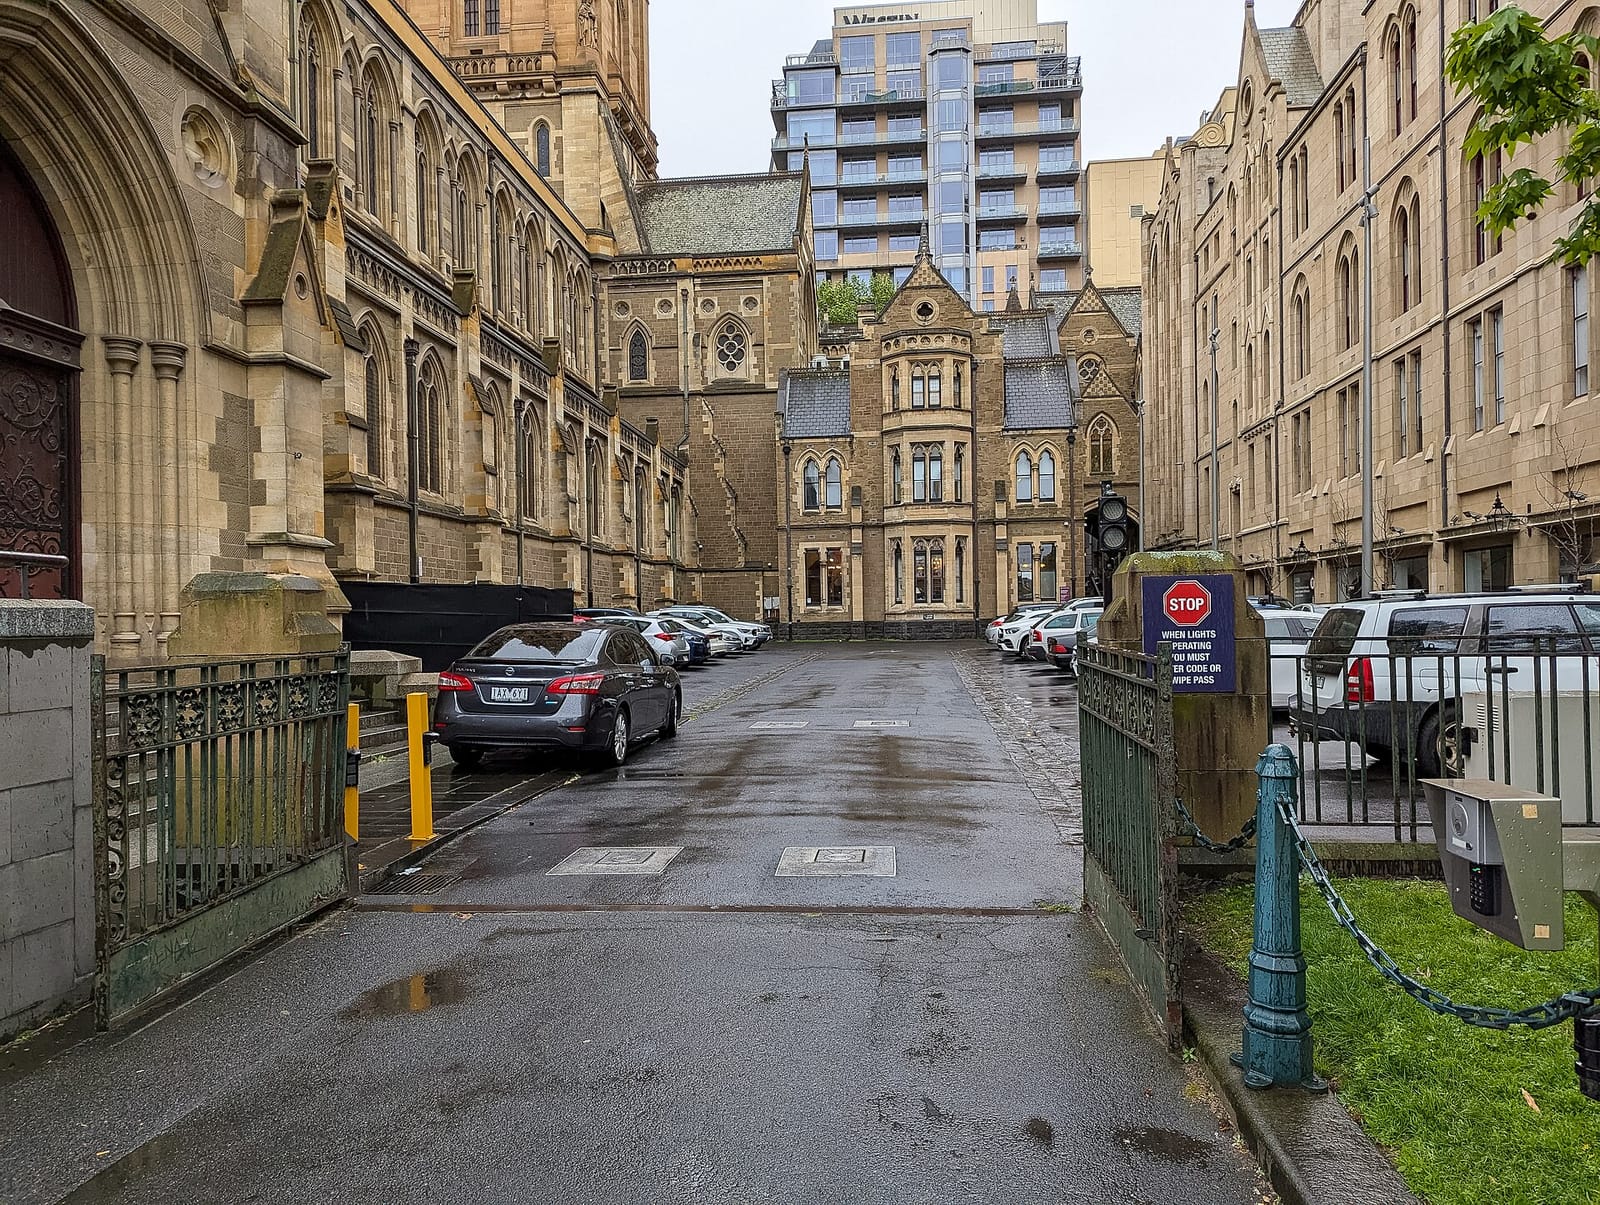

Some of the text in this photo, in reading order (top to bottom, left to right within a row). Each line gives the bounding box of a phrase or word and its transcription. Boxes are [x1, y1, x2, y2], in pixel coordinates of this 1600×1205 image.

[1169, 598, 1205, 611] STOP
[1161, 630, 1216, 639] WHEN LIGHTS
[1172, 642, 1212, 650] PERATING
[1187, 653, 1210, 662] MUST
[1186, 665, 1208, 673] CODE
[1210, 664, 1222, 673] OR
[1194, 676, 1215, 684] PASS
